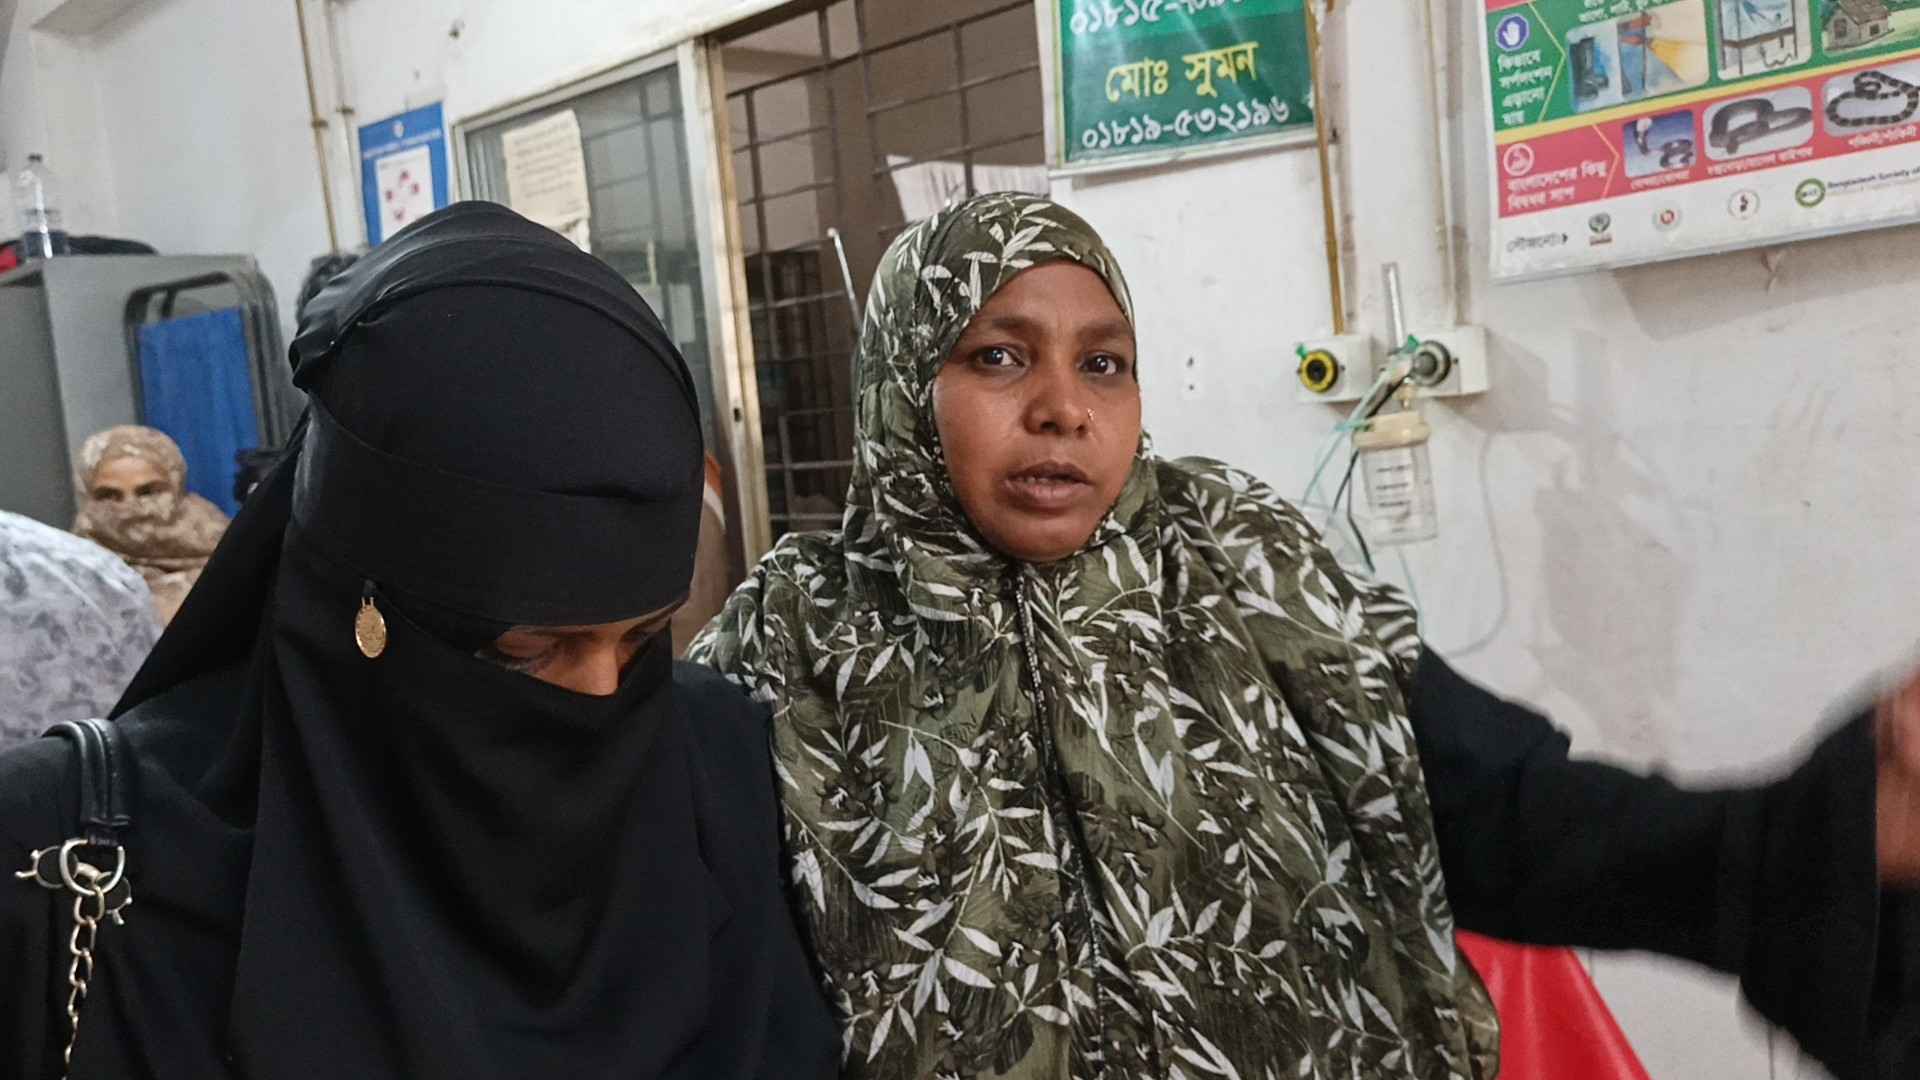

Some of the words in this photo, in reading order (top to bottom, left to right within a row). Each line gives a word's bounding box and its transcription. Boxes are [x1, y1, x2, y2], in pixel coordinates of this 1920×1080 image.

[1105, 57, 1169, 102] মোঃ
[1182, 41, 1259, 97] সুমন
[1081, 96, 1290, 149] ০১৮১৯-৫৩২১৯৬
